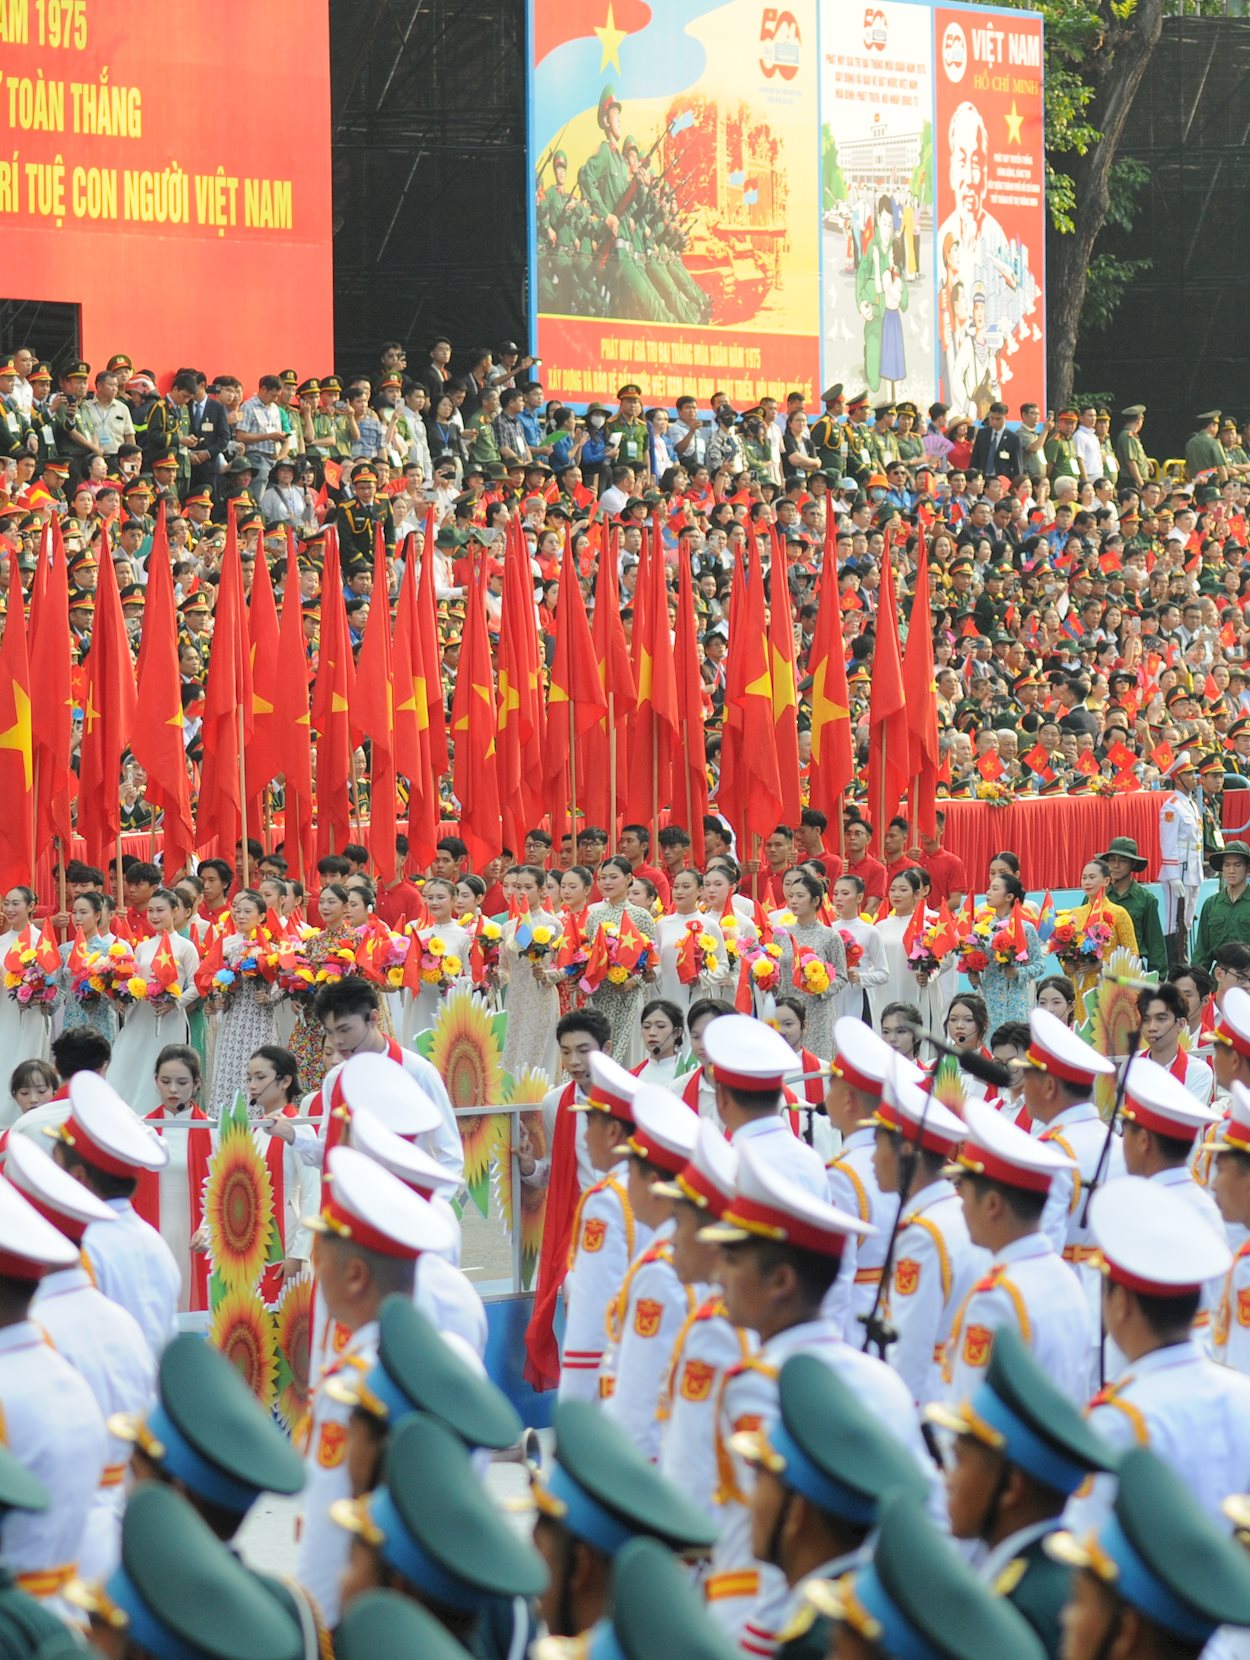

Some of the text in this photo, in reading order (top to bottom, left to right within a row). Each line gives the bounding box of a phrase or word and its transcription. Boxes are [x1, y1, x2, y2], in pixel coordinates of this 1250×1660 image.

[36, 0, 88, 50] 1975
[971, 21, 1005, 69] VIỆT
[1008, 32, 1040, 67] NAM
[7, 68, 64, 132] TOÀN
[70, 65, 142, 138] THẮNG
[992, 74, 1010, 92] CHÍ
[1013, 78, 1039, 95] MINH
[25, 154, 66, 227] TUỆ
[72, 166, 117, 220] CON
[124, 160, 189, 223] NGƯỜI
[195, 165, 239, 236] VIỆT
[245, 178, 292, 229] NAM
